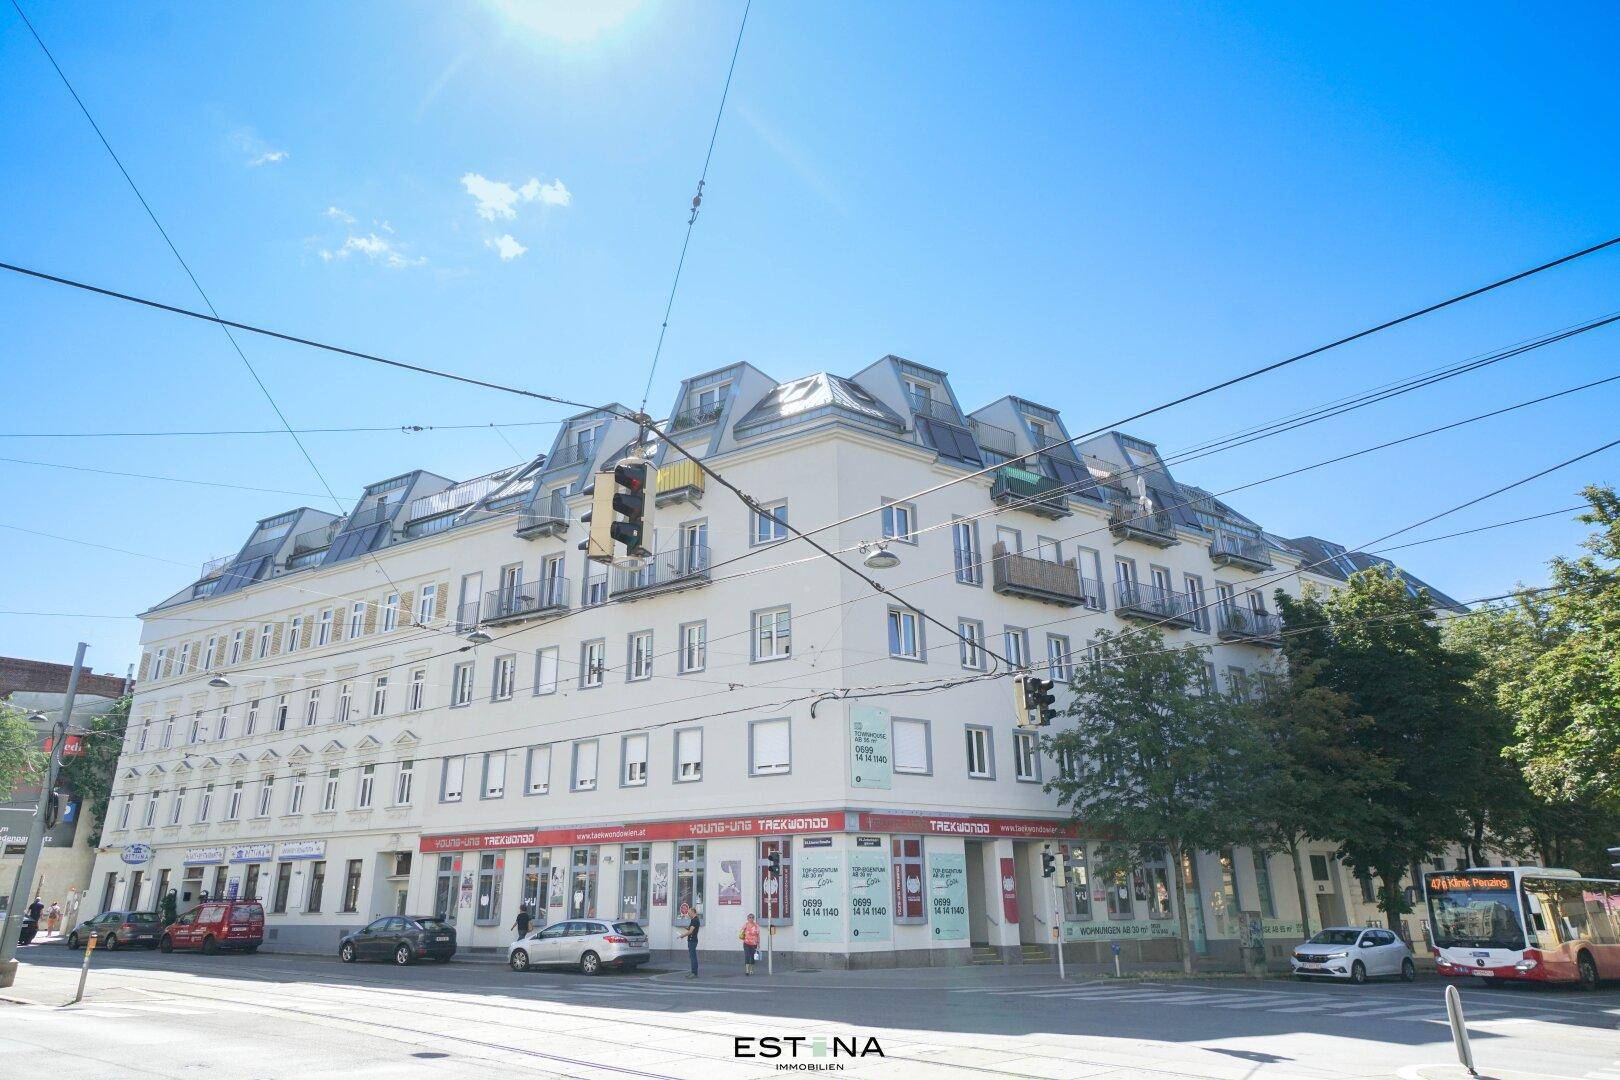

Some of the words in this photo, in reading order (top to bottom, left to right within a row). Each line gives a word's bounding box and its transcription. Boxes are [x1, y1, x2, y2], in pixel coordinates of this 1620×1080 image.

[854, 731, 887, 740] TOWNHOUSE
[855, 745, 873, 754] 0699
[865, 754, 872, 762] 14
[873, 755, 887, 763] 1140
[690, 819, 752, 834] YOUNG-UNG
[757, 817, 829, 830] TAEKWONDO
[929, 819, 990, 834] TAEKWONDO
[435, 836, 480, 848] YOUNG-UNG
[484, 833, 534, 846] TAEKWONDO
[576, 829, 646, 840] www.taekwondowien.at
[1448, 876, 1471, 888] Klinik
[1472, 877, 1508, 889] Penzing
[802, 899, 822, 907] 0699
[852, 899, 872, 907] 0699
[933, 898, 951, 906] 0699
[803, 908, 811, 916] 14
[812, 908, 820, 916] 14
[822, 908, 839, 916] 1140
[853, 907, 860, 915] 14
[862, 907, 870, 915] 14
[871, 907, 886, 916] 1140
[934, 906, 941, 914] 14
[943, 906, 949, 914] 14
[951, 906, 965, 914] 1140
[1080, 926, 1121, 936] WOHNUNGEN
[1131, 926, 1140, 934] 30
